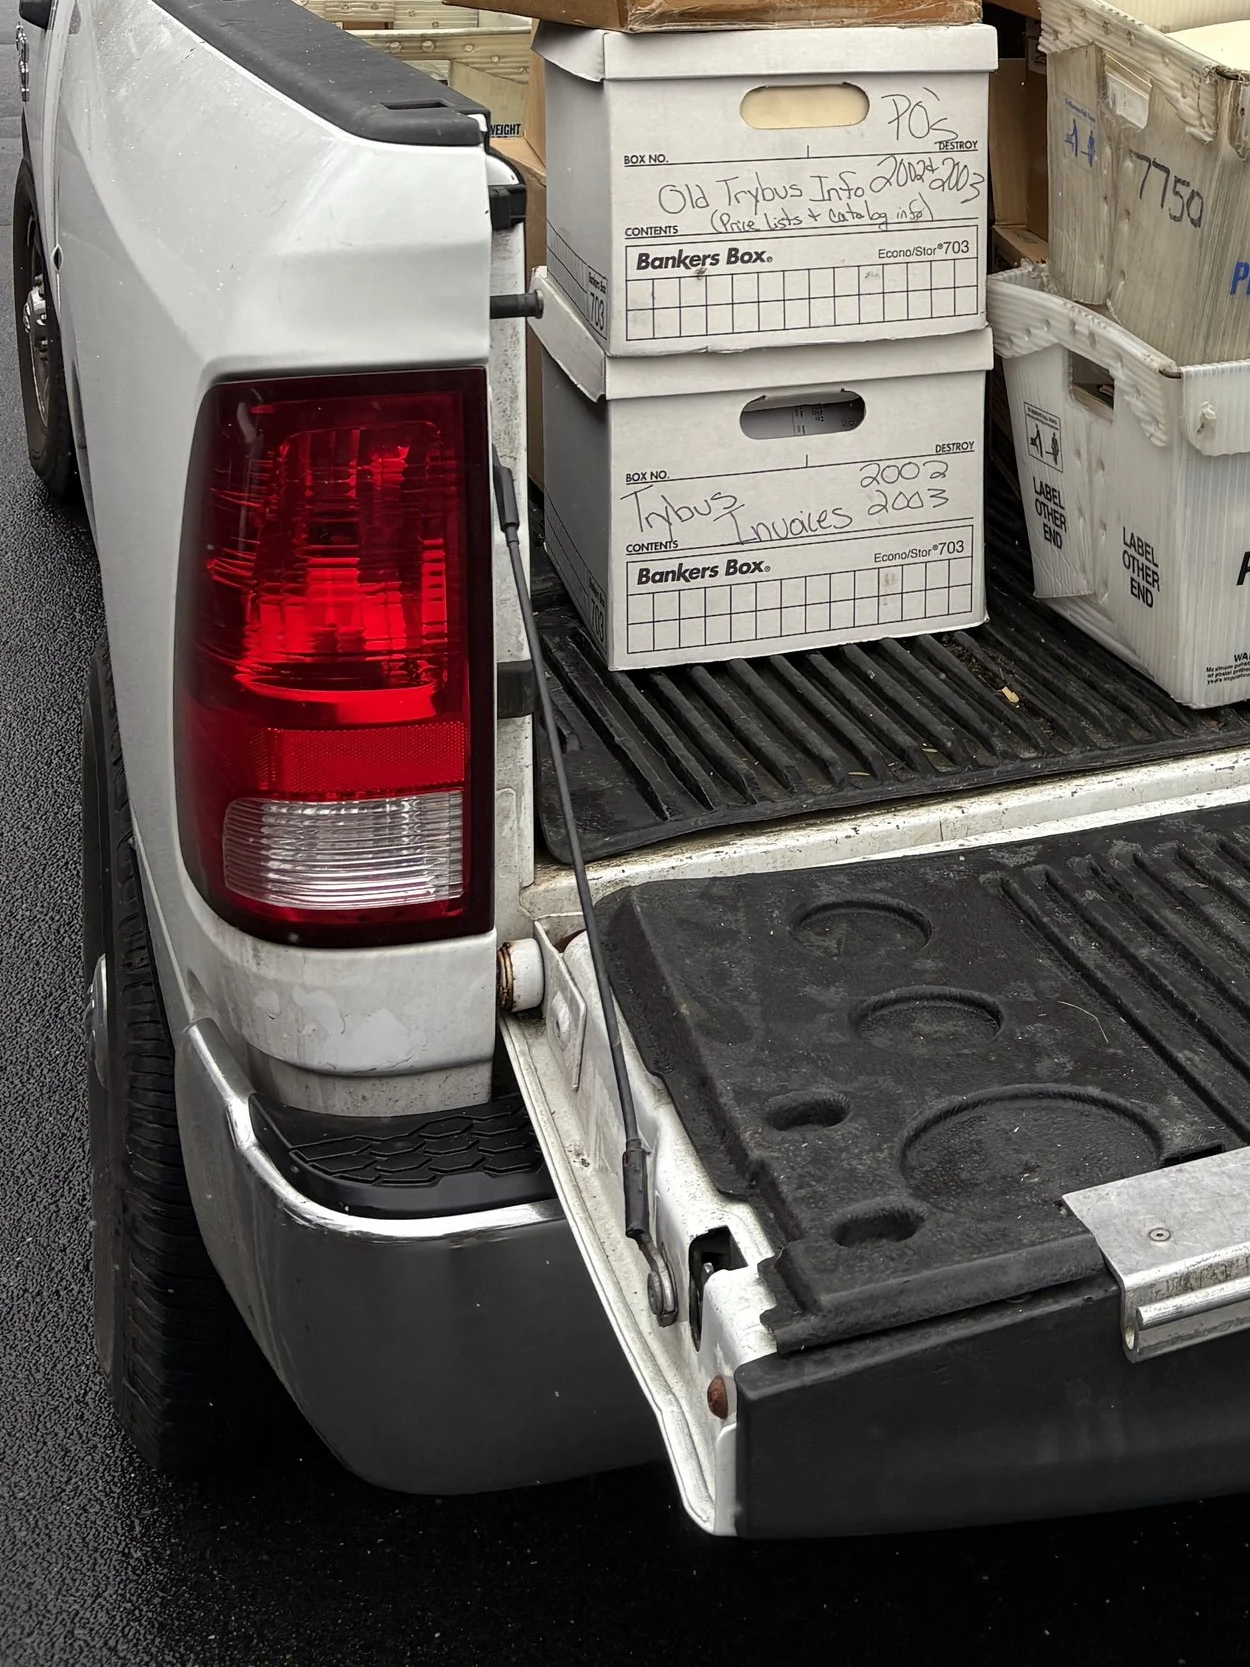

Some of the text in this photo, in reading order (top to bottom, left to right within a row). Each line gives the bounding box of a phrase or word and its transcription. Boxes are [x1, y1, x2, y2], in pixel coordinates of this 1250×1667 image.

[624, 154, 669, 165] BOX NO.
[938, 140, 979, 151] DESTROY
[659, 184, 709, 214] Old
[716, 172, 802, 215] Trybus
[809, 171, 864, 202] Info
[1128, 148, 1204, 229] 7750
[625, 225, 679, 237] CONTENTS
[636, 247, 720, 271] Bankers
[935, 441, 975, 453] DESTROY
[626, 470, 670, 483] BOX NO.
[859, 460, 949, 488] 2002
[867, 488, 949, 516] 2003
[1032, 476, 1065, 510] LABEL
[620, 484, 738, 542] Trybus
[1035, 499, 1067, 533] OTHER
[626, 540, 679, 554] CONTENTS
[1043, 523, 1063, 551] END
[1122, 526, 1159, 568] LABEL
[637, 563, 719, 585] Bankers
[1122, 551, 1160, 592] OTHER
[1130, 577, 1154, 608] END
